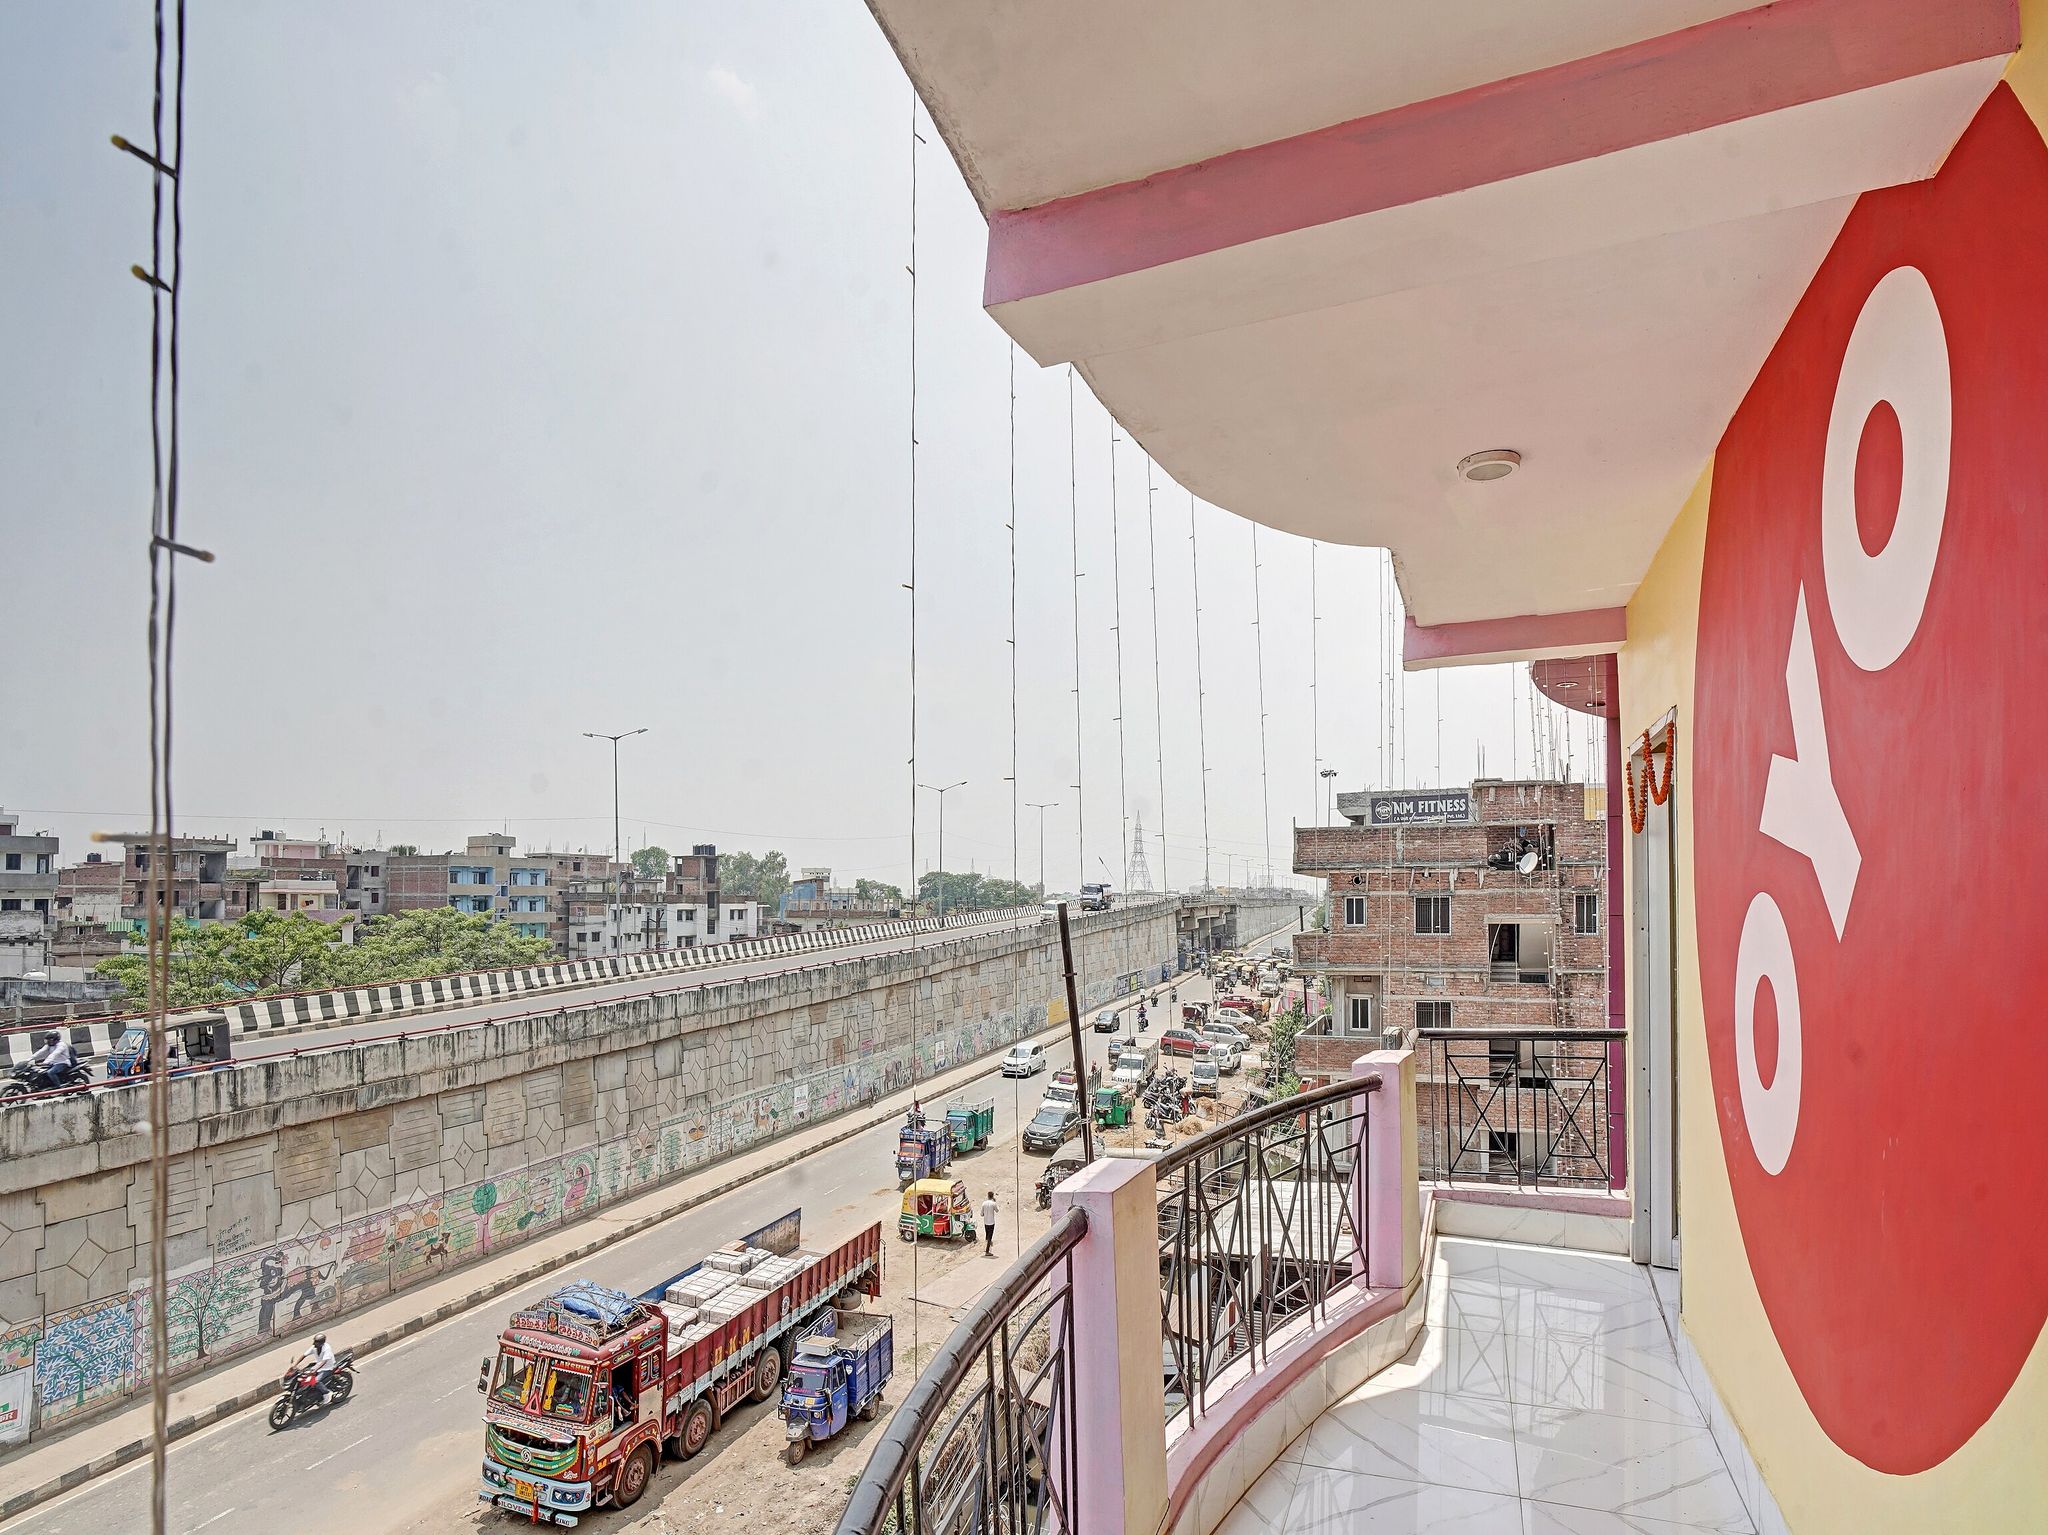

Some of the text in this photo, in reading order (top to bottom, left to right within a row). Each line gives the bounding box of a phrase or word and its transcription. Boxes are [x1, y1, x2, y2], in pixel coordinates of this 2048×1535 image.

[1392, 801, 1414, 815] NM
[1418, 799, 1466, 814] FITNESS
[554, 1359, 591, 1374] LAKSHMI
